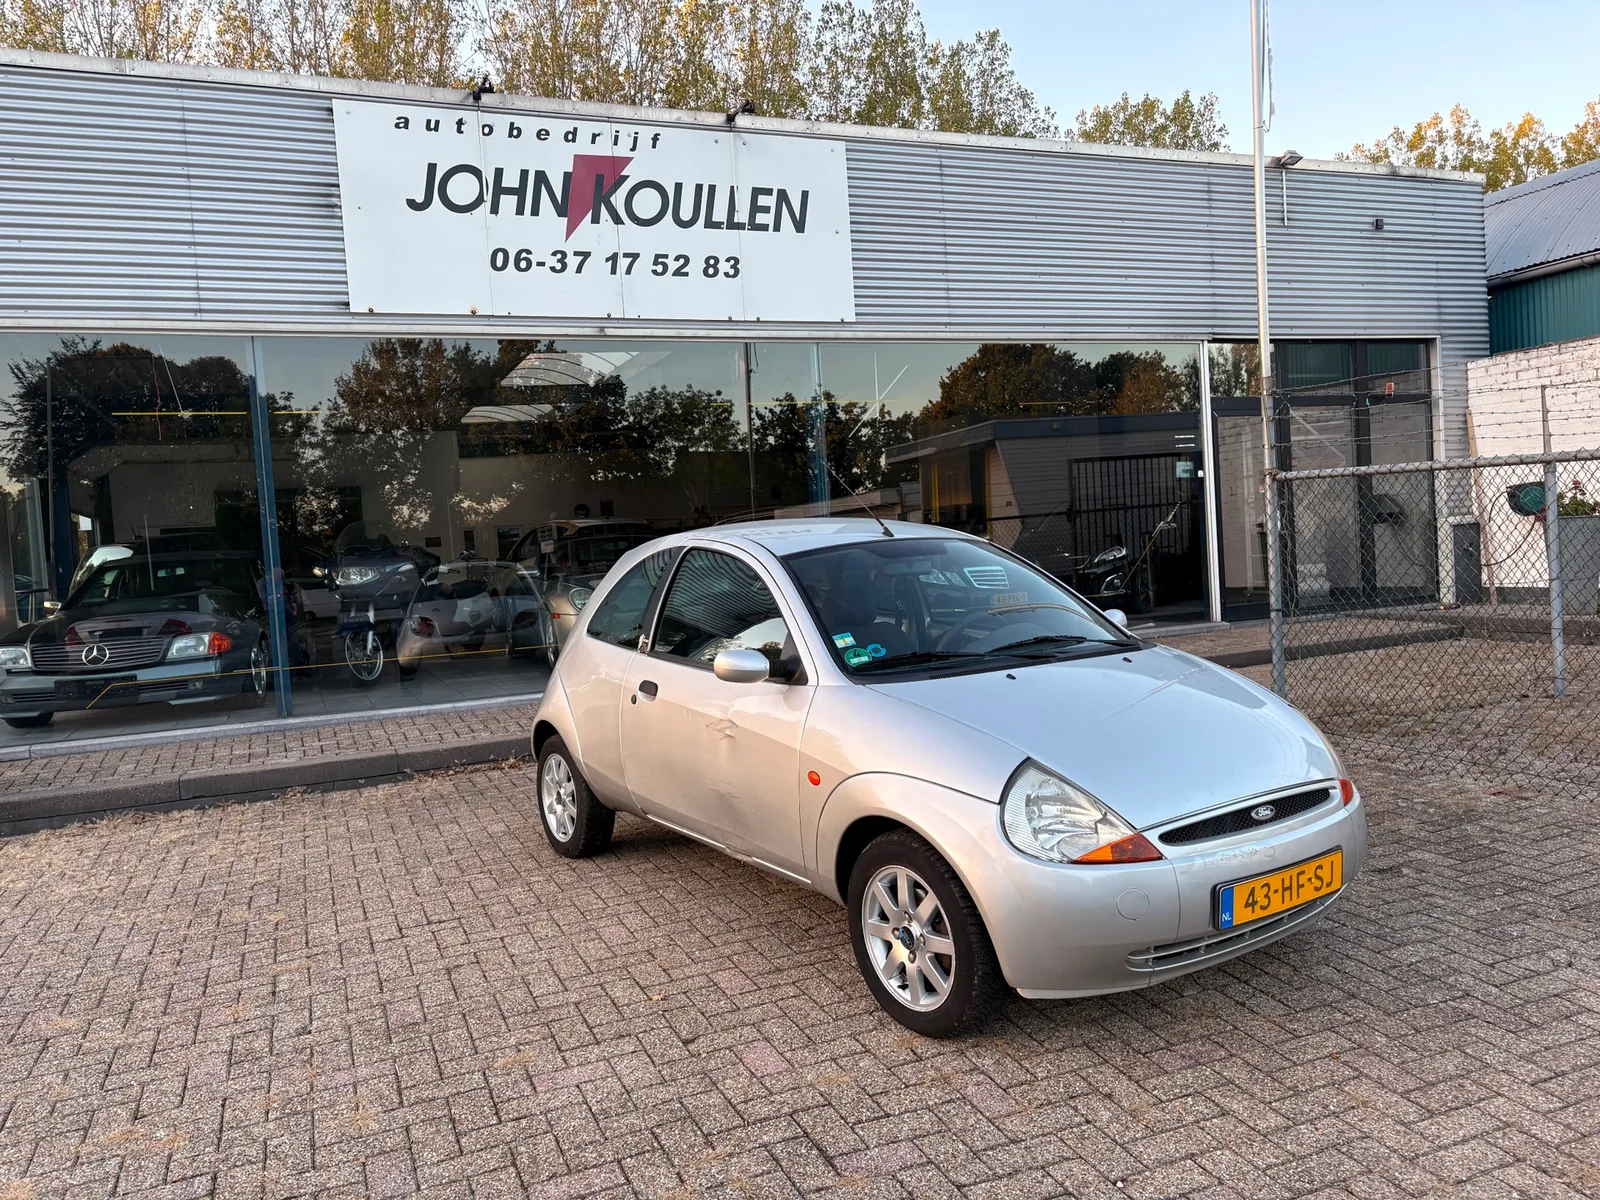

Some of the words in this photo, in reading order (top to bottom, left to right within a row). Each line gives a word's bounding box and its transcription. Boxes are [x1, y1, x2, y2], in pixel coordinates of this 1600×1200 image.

[394, 115, 661, 152] autobedrijf
[406, 162, 572, 218] JOHN
[590, 173, 810, 234] KOULLEN
[489, 247, 592, 274] 06-37
[604, 251, 641, 276] 17
[651, 253, 691, 277] 52
[702, 255, 741, 279] 83
[1244, 860, 1334, 914] 43-HF-SJ
[1222, 912, 1232, 922] NL
